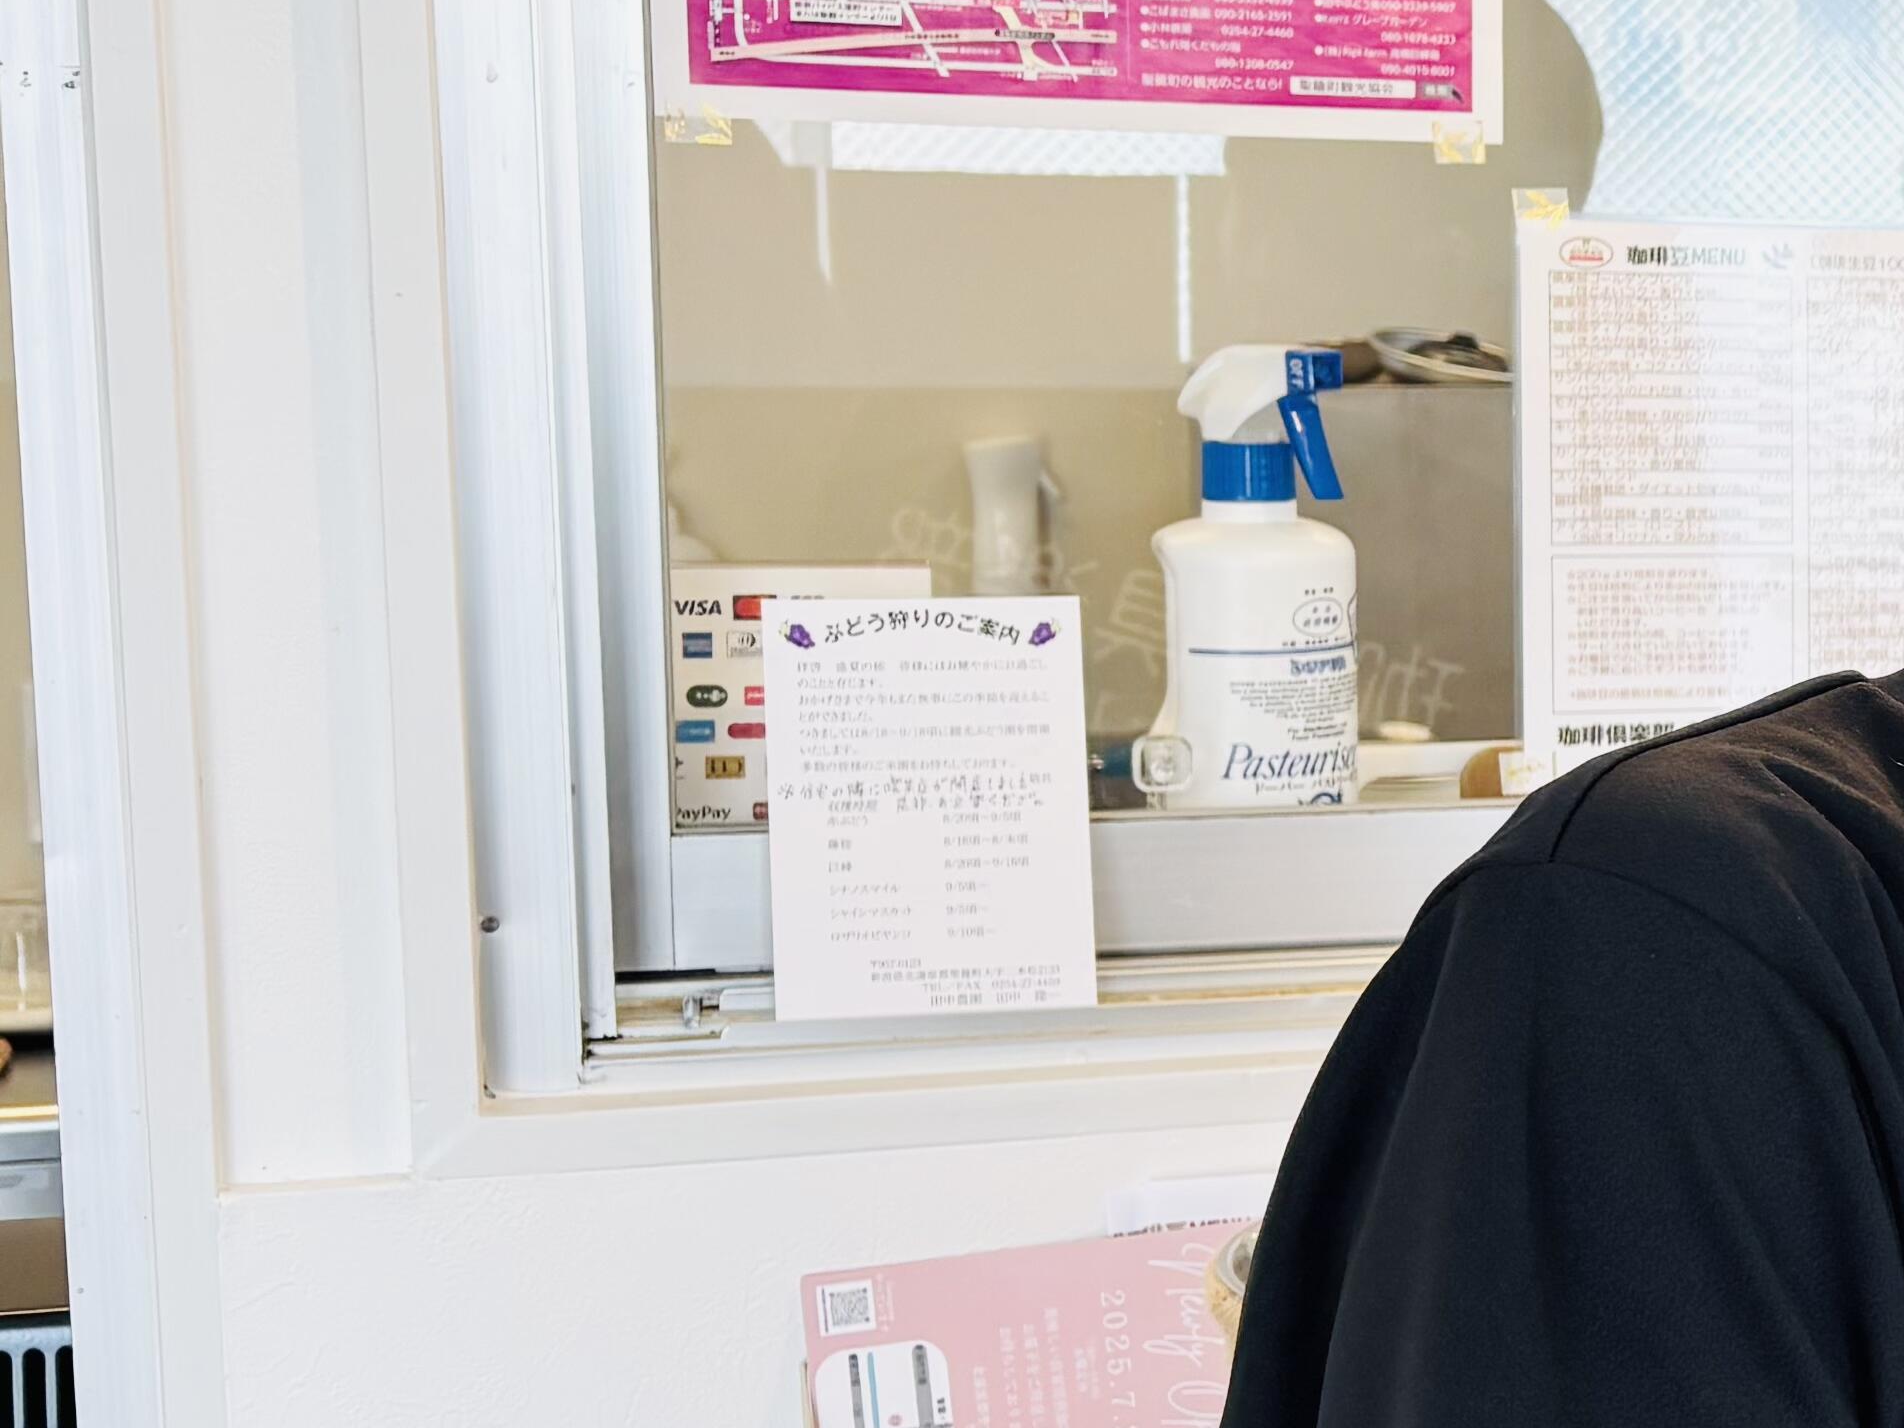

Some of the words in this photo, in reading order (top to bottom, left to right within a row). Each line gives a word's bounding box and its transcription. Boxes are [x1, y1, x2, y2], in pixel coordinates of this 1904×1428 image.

[674, 599, 723, 617] VISA
[824, 608, 1022, 646] ぶどう狩りのご案内
